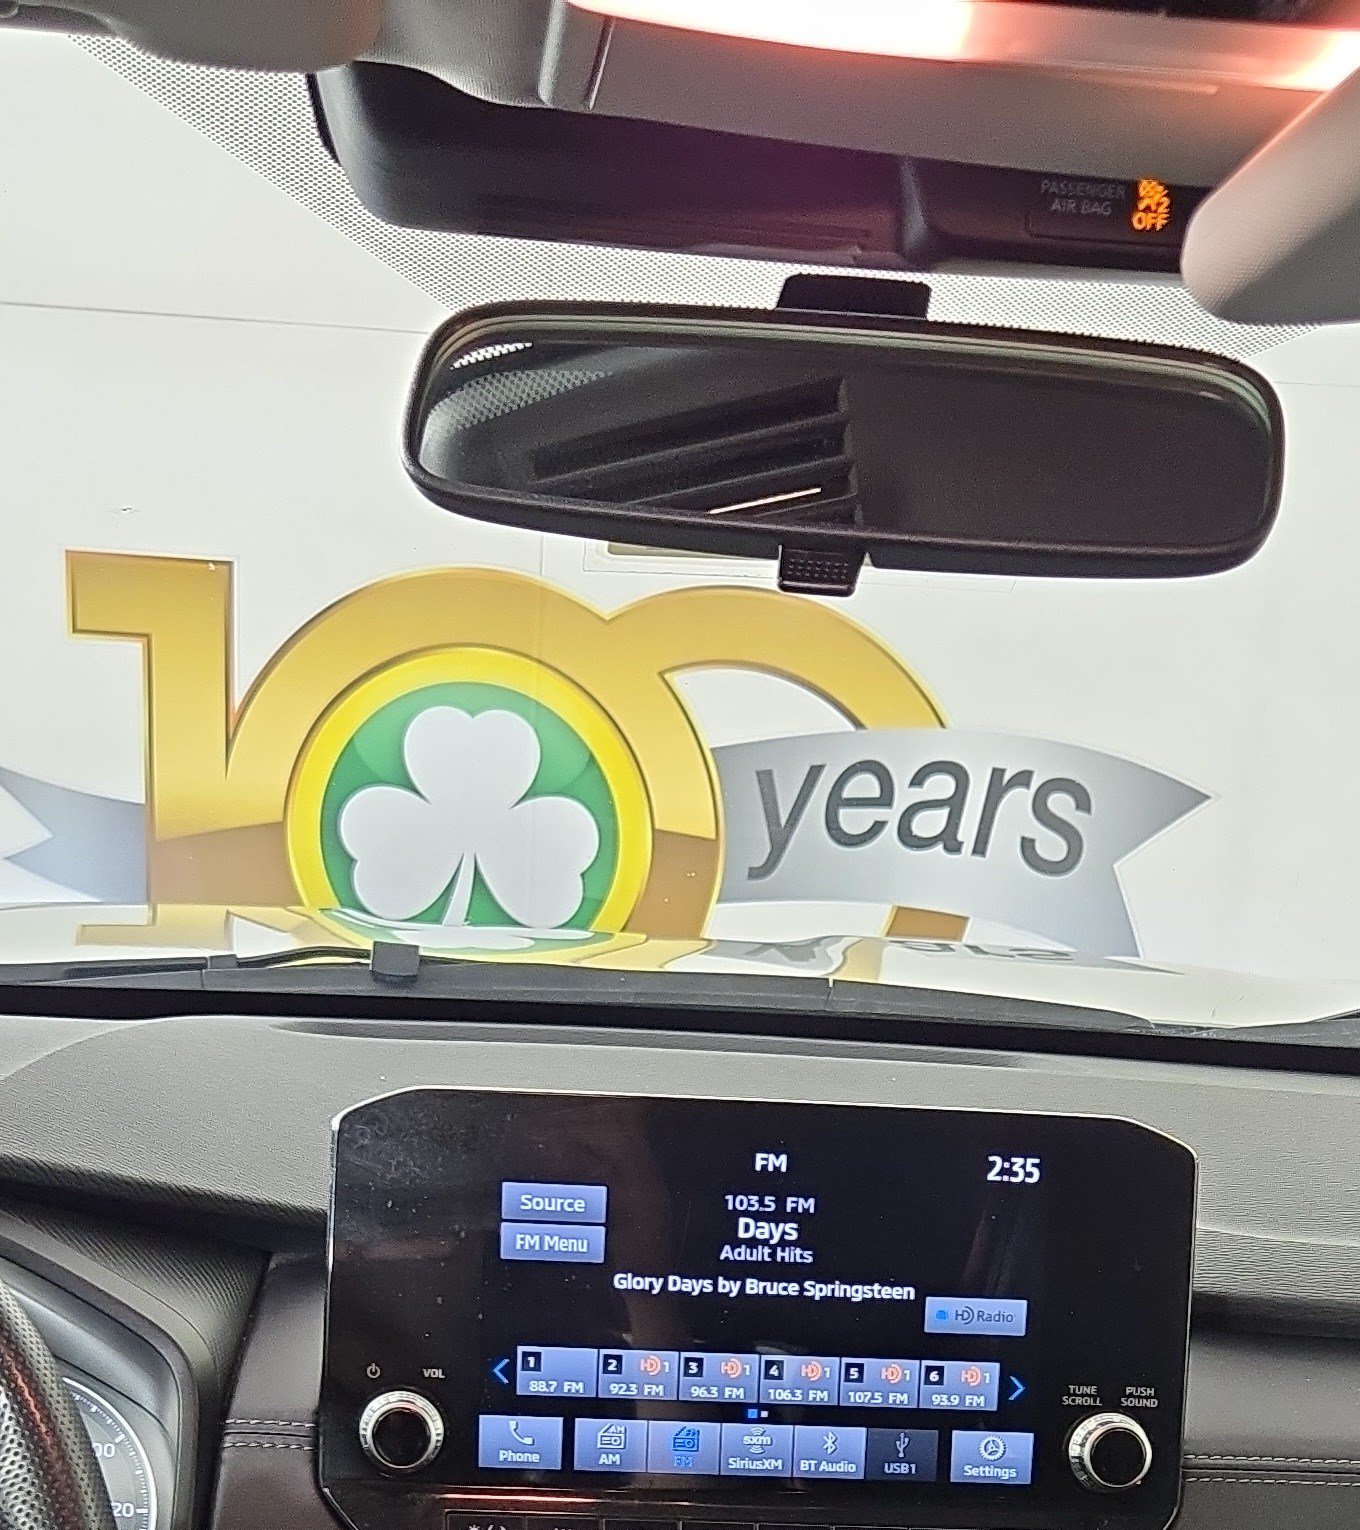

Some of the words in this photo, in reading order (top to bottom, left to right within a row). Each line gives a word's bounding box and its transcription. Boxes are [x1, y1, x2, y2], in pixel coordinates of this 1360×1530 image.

[1041, 180, 1125, 198] PASSENGER
[1051, 200, 1077, 213] AIR
[1081, 202, 1112, 217] BAG
[1132, 212, 1170, 231] OFF
[748, 756, 1096, 880] years
[755, 1153, 787, 1173] FM
[986, 1155, 1041, 1184] 2:35
[520, 1194, 586, 1214] Source
[724, 1195, 776, 1213] 103.5
[787, 1196, 815, 1214] FM
[737, 1217, 799, 1243] Days
[515, 1234, 539, 1252] FM
[543, 1235, 589, 1254] Menu
[720, 1244, 772, 1264] Adult
[776, 1246, 813, 1265] Hits
[613, 1273, 665, 1296] Glory
[667, 1275, 713, 1297] Days
[717, 1276, 742, 1298] by
[745, 1278, 800, 1297] Bruce
[804, 1280, 916, 1301] Springsteen
[977, 1309, 1014, 1323] Radio
[608, 1360, 618, 1371] 2
[688, 1363, 698, 1374] 3
[769, 1365, 779, 1376] 4
[422, 1368, 446, 1379] VOL
[849, 1367, 859, 1379] 5
[929, 1370, 939, 1382] 6
[529, 1381, 557, 1393] 88.7
[563, 1382, 584, 1394] FM
[609, 1384, 638, 1395] 92.3
[643, 1385, 664, 1397] FM
[690, 1386, 719, 1398] 96.3
[724, 1387, 745, 1399] FM
[1068, 1385, 1099, 1395] TUNE
[1125, 1386, 1155, 1397] PUSH
[768, 1389, 803, 1401] 106.3
[808, 1390, 829, 1402] FM
[848, 1391, 883, 1403] 107.5
[888, 1393, 909, 1405] FM
[931, 1394, 960, 1406] 93.9
[965, 1396, 985, 1407] FM
[1062, 1396, 1103, 1407] SCROLL
[1120, 1397, 1159, 1408] SOUND
[498, 1450, 540, 1463] Phone
[598, 1453, 621, 1465] AM
[674, 1456, 694, 1468] FM
[728, 1457, 783, 1471] SiriusXM
[800, 1460, 818, 1471] BT
[821, 1460, 857, 1474] Audio
[963, 1464, 1018, 1480] Settings
